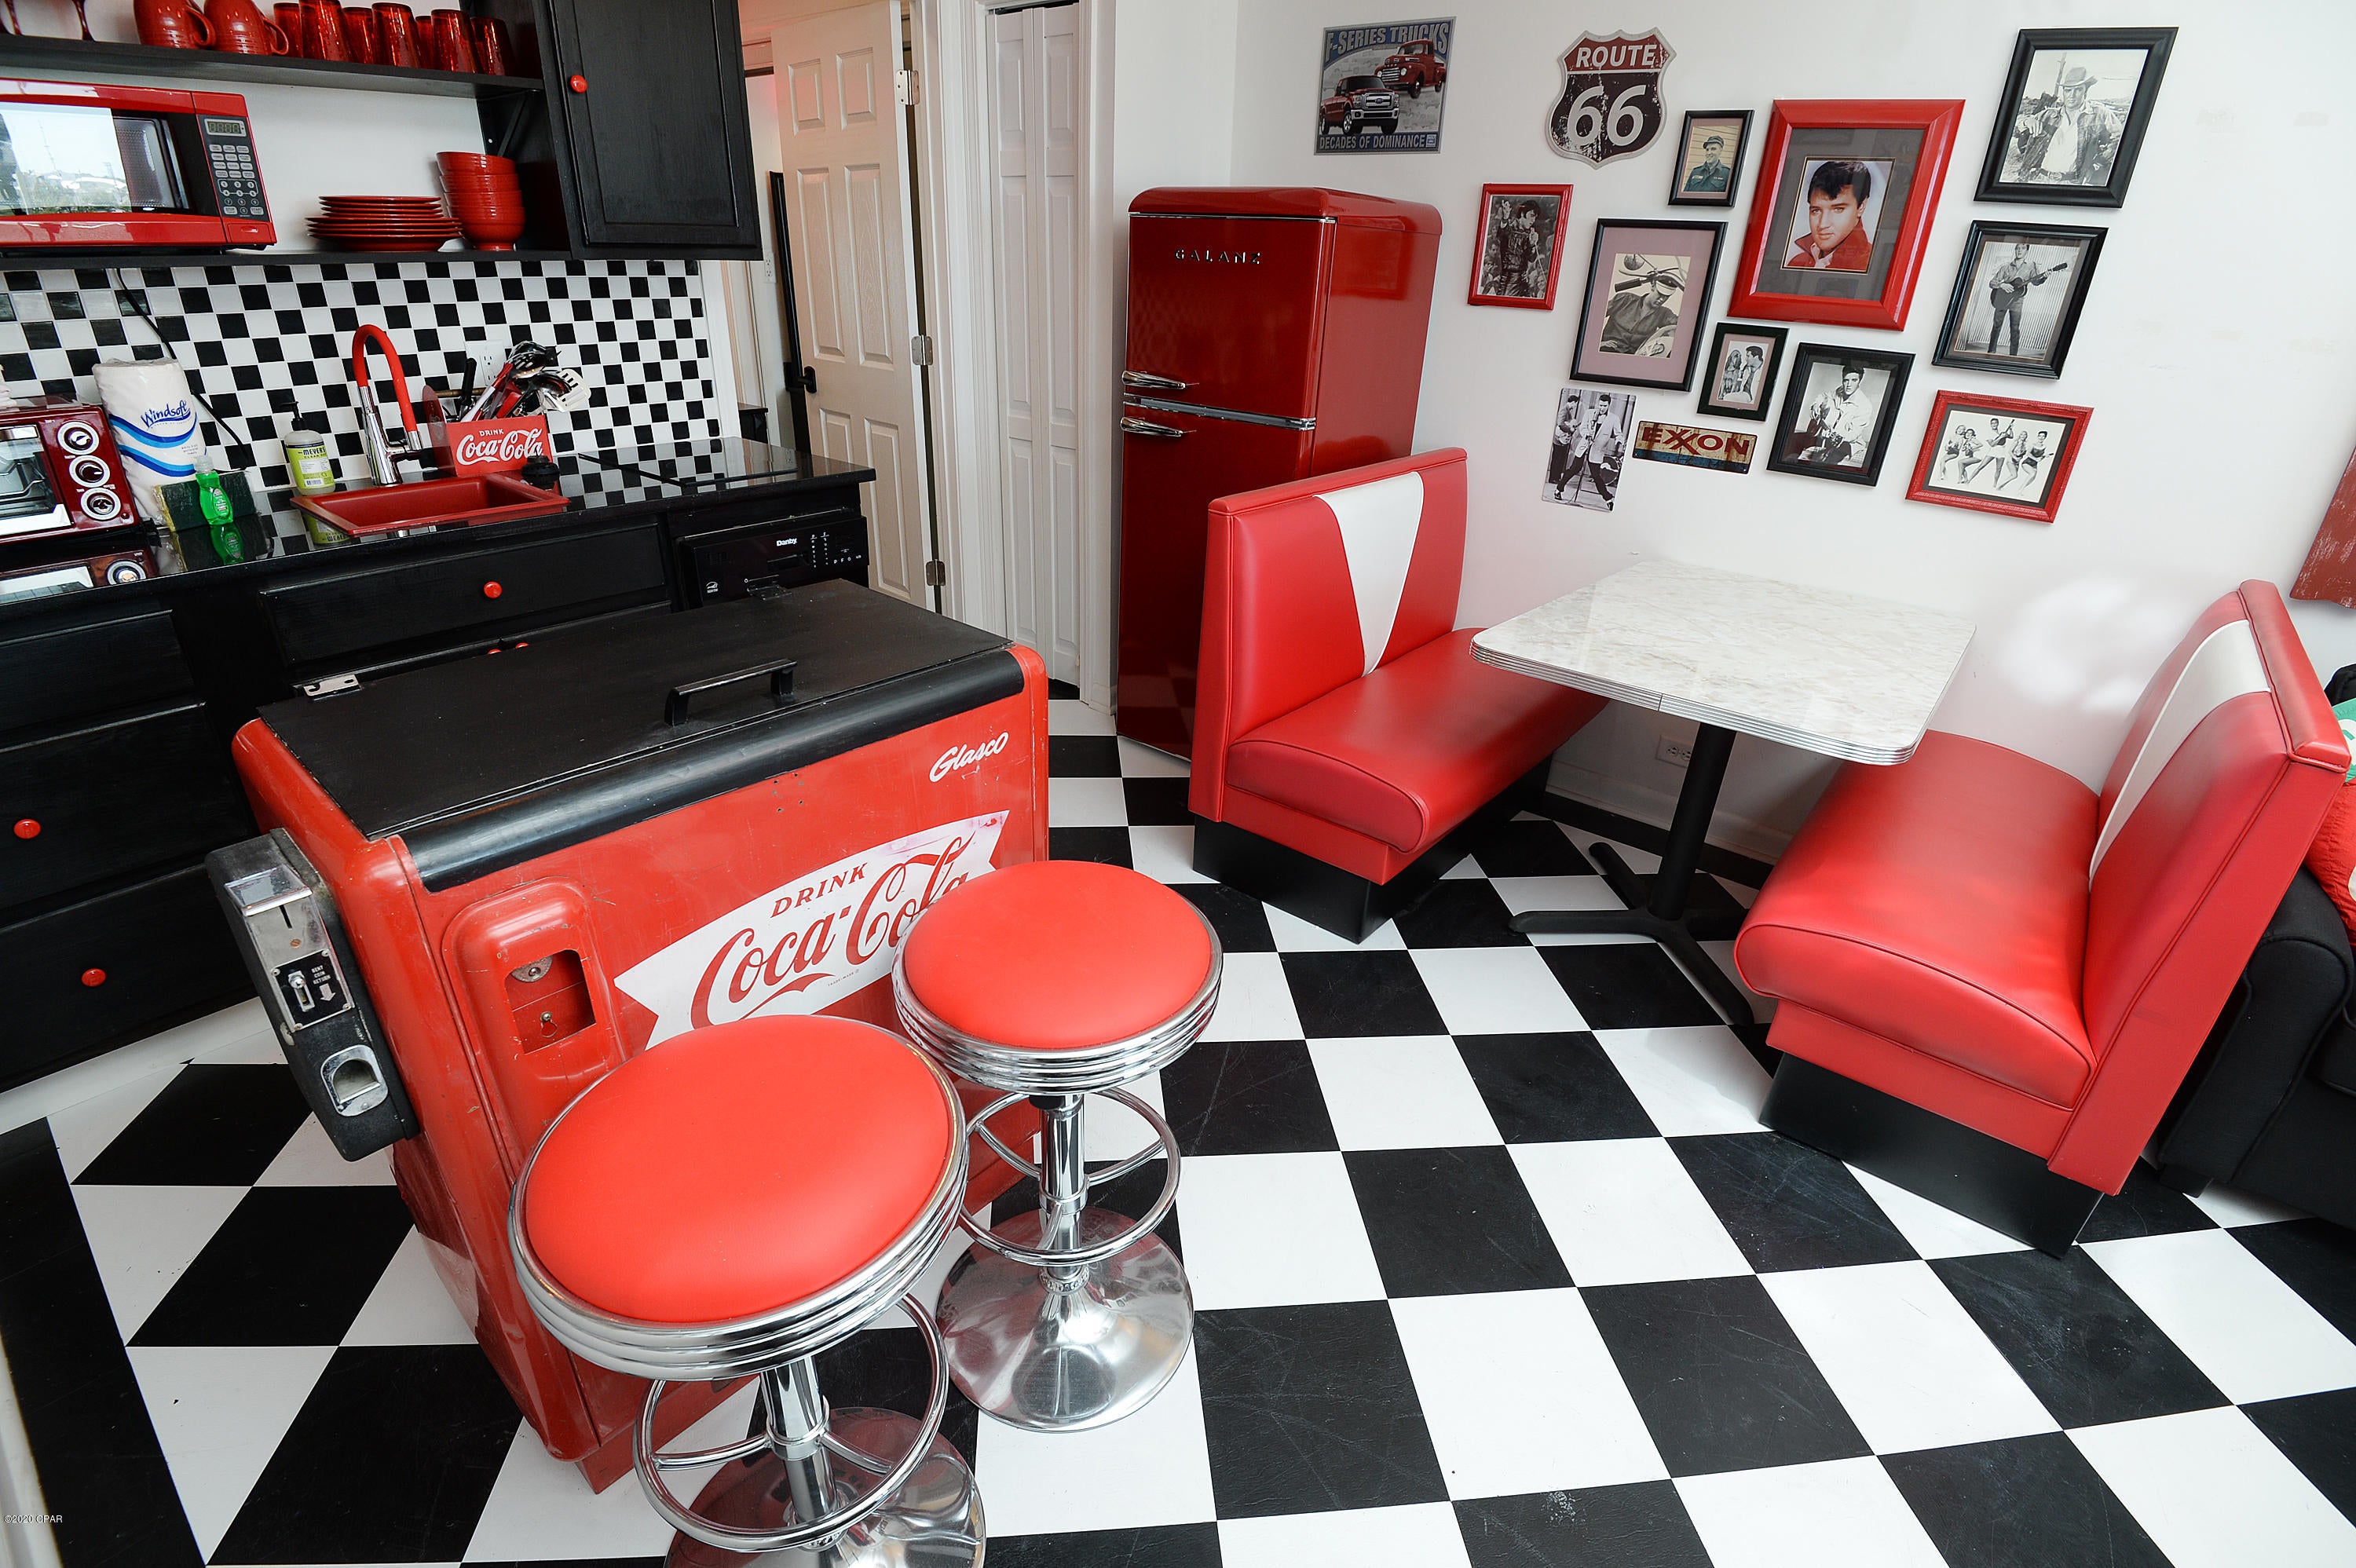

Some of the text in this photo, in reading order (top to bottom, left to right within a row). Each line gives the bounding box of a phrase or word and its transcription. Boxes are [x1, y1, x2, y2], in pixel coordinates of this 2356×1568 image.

[1326, 22, 1449, 62] F-SERIES TRUCKS
[1575, 44, 1657, 68] ROUTE
[1567, 84, 1647, 147] 66
[1319, 136, 1357, 149] DECADES
[1359, 136, 1370, 148] OF
[1373, 134, 1426, 148] DOMINANCE
[1175, 249, 1261, 265] GALANZ
[141, 400, 188, 428] Windsoft
[456, 428, 543, 466] Coca-Cola
[1641, 426, 1751, 456] EXXON
[776, 537, 797, 546] Danby
[929, 732, 1009, 783] Glasco
[771, 862, 868, 918] DRINK
[313, 974, 331, 985] RETURN
